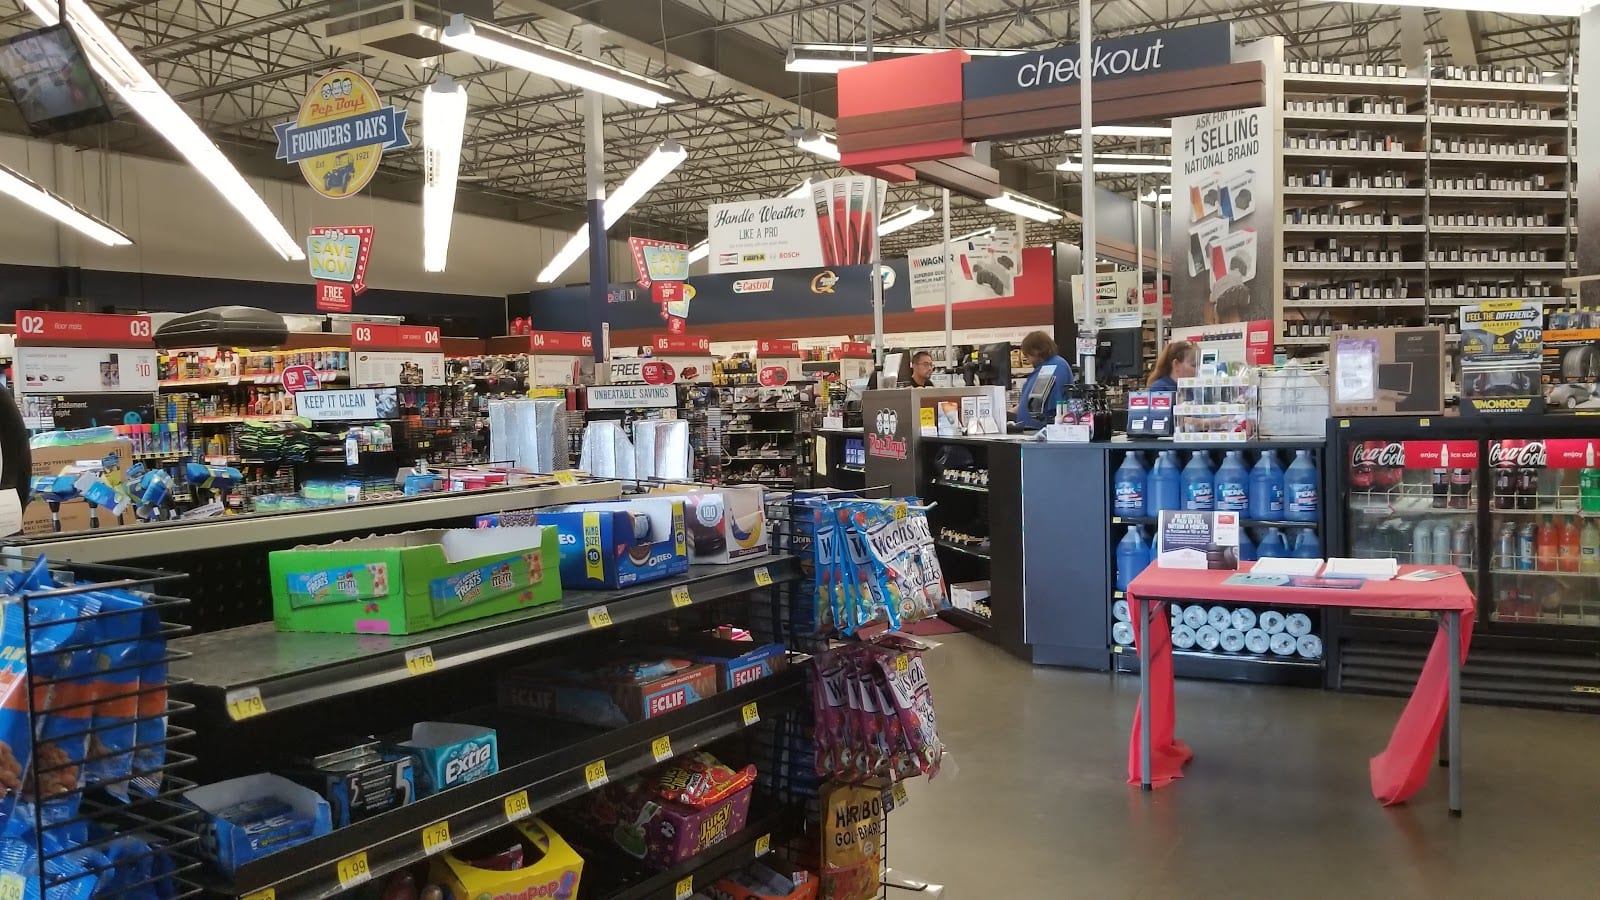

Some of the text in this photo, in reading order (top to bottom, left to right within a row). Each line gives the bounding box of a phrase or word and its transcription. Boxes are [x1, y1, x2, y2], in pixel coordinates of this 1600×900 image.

[1017, 38, 1164, 88] checkout
[335, 94, 365, 111] Boys
[1196, 112, 1211, 130] ASK
[1213, 109, 1228, 126] FOR
[292, 115, 387, 154] FOUNDERS DAYS
[1185, 114, 1259, 156] #1 SELLING
[355, 152, 369, 161] 1921
[1184, 140, 1259, 175] NATIONAL BRAND
[714, 203, 806, 228] Handle Weather
[739, 226, 778, 240] LIKE A PRO
[312, 239, 353, 259] SAVE
[779, 251, 800, 259] BOSCH
[312, 255, 352, 274] NOW
[920, 253, 954, 267] WAGNR
[324, 285, 344, 299] FREE
[743, 279, 770, 291] Castrol
[1466, 310, 1536, 322] FEEL THE DIFFERENCE
[21, 316, 44, 334] 02
[130, 320, 150, 337] 03
[1515, 328, 1541, 340] STOP
[356, 327, 371, 341] 03
[425, 330, 439, 344] 04
[534, 334, 544, 346] 04
[581, 336, 592, 347] 05
[658, 338, 668, 349] 05
[699, 338, 708, 349] 06
[761, 342, 769, 351] 06
[136, 363, 151, 377] $10
[611, 363, 640, 376] FREE
[304, 393, 366, 409] KEEP IT CLEAN
[594, 388, 669, 400] UNBEATABLE SAVINGS
[1480, 399, 1524, 409] MONROE
[703, 505, 715, 518] 100
[559, 533, 576, 545] EO
[589, 551, 598, 561] 10
[649, 552, 673, 567] OREO
[456, 574, 482, 602] TREATS
[591, 612, 610, 625] 1.99
[410, 654, 434, 669] 1.79
[740, 666, 761, 684] CLIF
[231, 696, 260, 712] 1.79
[658, 690, 684, 712] CLIF
[744, 707, 758, 719] 1.99
[654, 742, 670, 754] 1.99
[445, 743, 491, 785] Extra
[587, 767, 606, 780] 2.99
[508, 797, 527, 812] 1.99
[835, 796, 881, 829] HARIBO
[700, 802, 732, 841] JUICY
[425, 828, 448, 843] 1.79
[705, 820, 727, 843] DROP
[341, 861, 366, 877] 1.99
[527, 880, 559, 900] Pop
